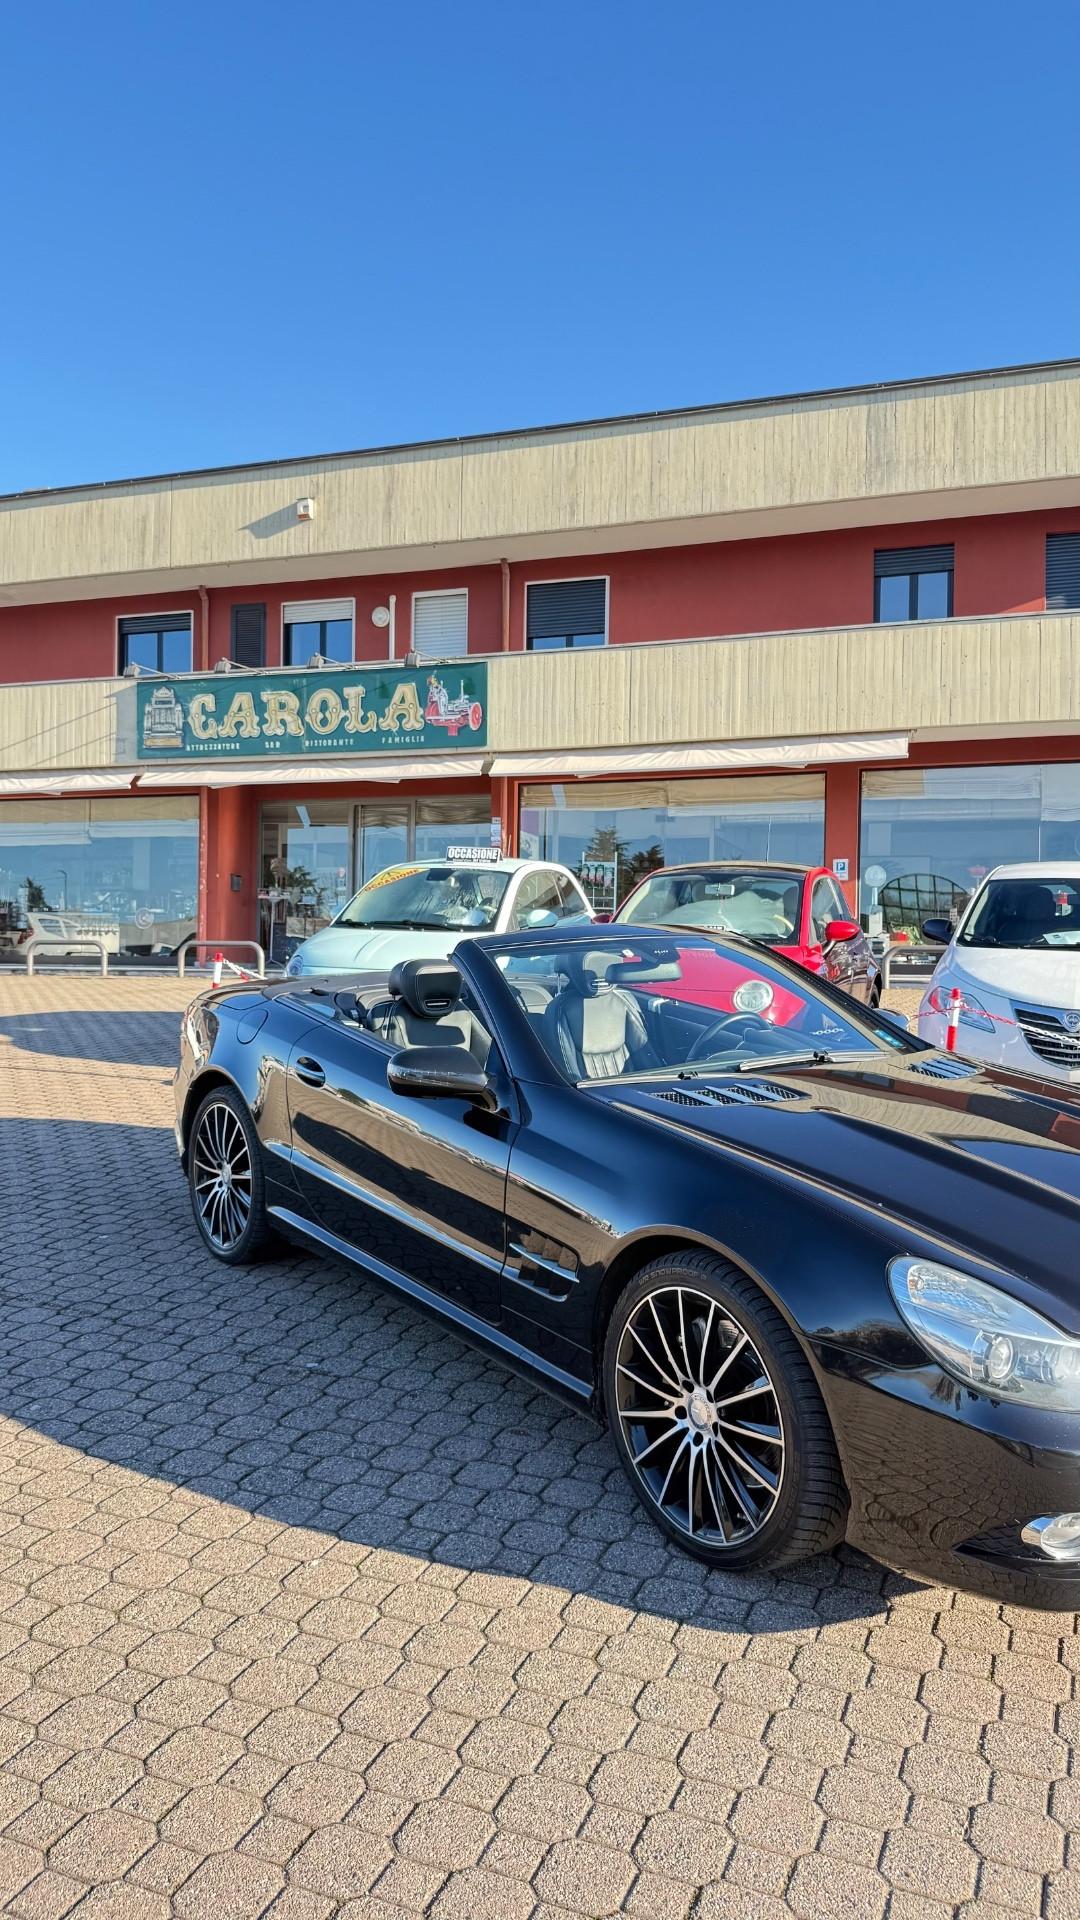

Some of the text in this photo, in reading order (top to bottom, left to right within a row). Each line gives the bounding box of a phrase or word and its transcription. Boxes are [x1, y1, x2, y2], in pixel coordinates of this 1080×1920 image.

[187, 682, 424, 739] CAROLA
[186, 743, 240, 751] ATTREZZATURE
[305, 738, 354, 746] RISTORANTE
[382, 735, 425, 743] FAMIGLIA
[448, 848, 498, 860] OCCASIONE
[364, 868, 417, 892] OCCASIONE
